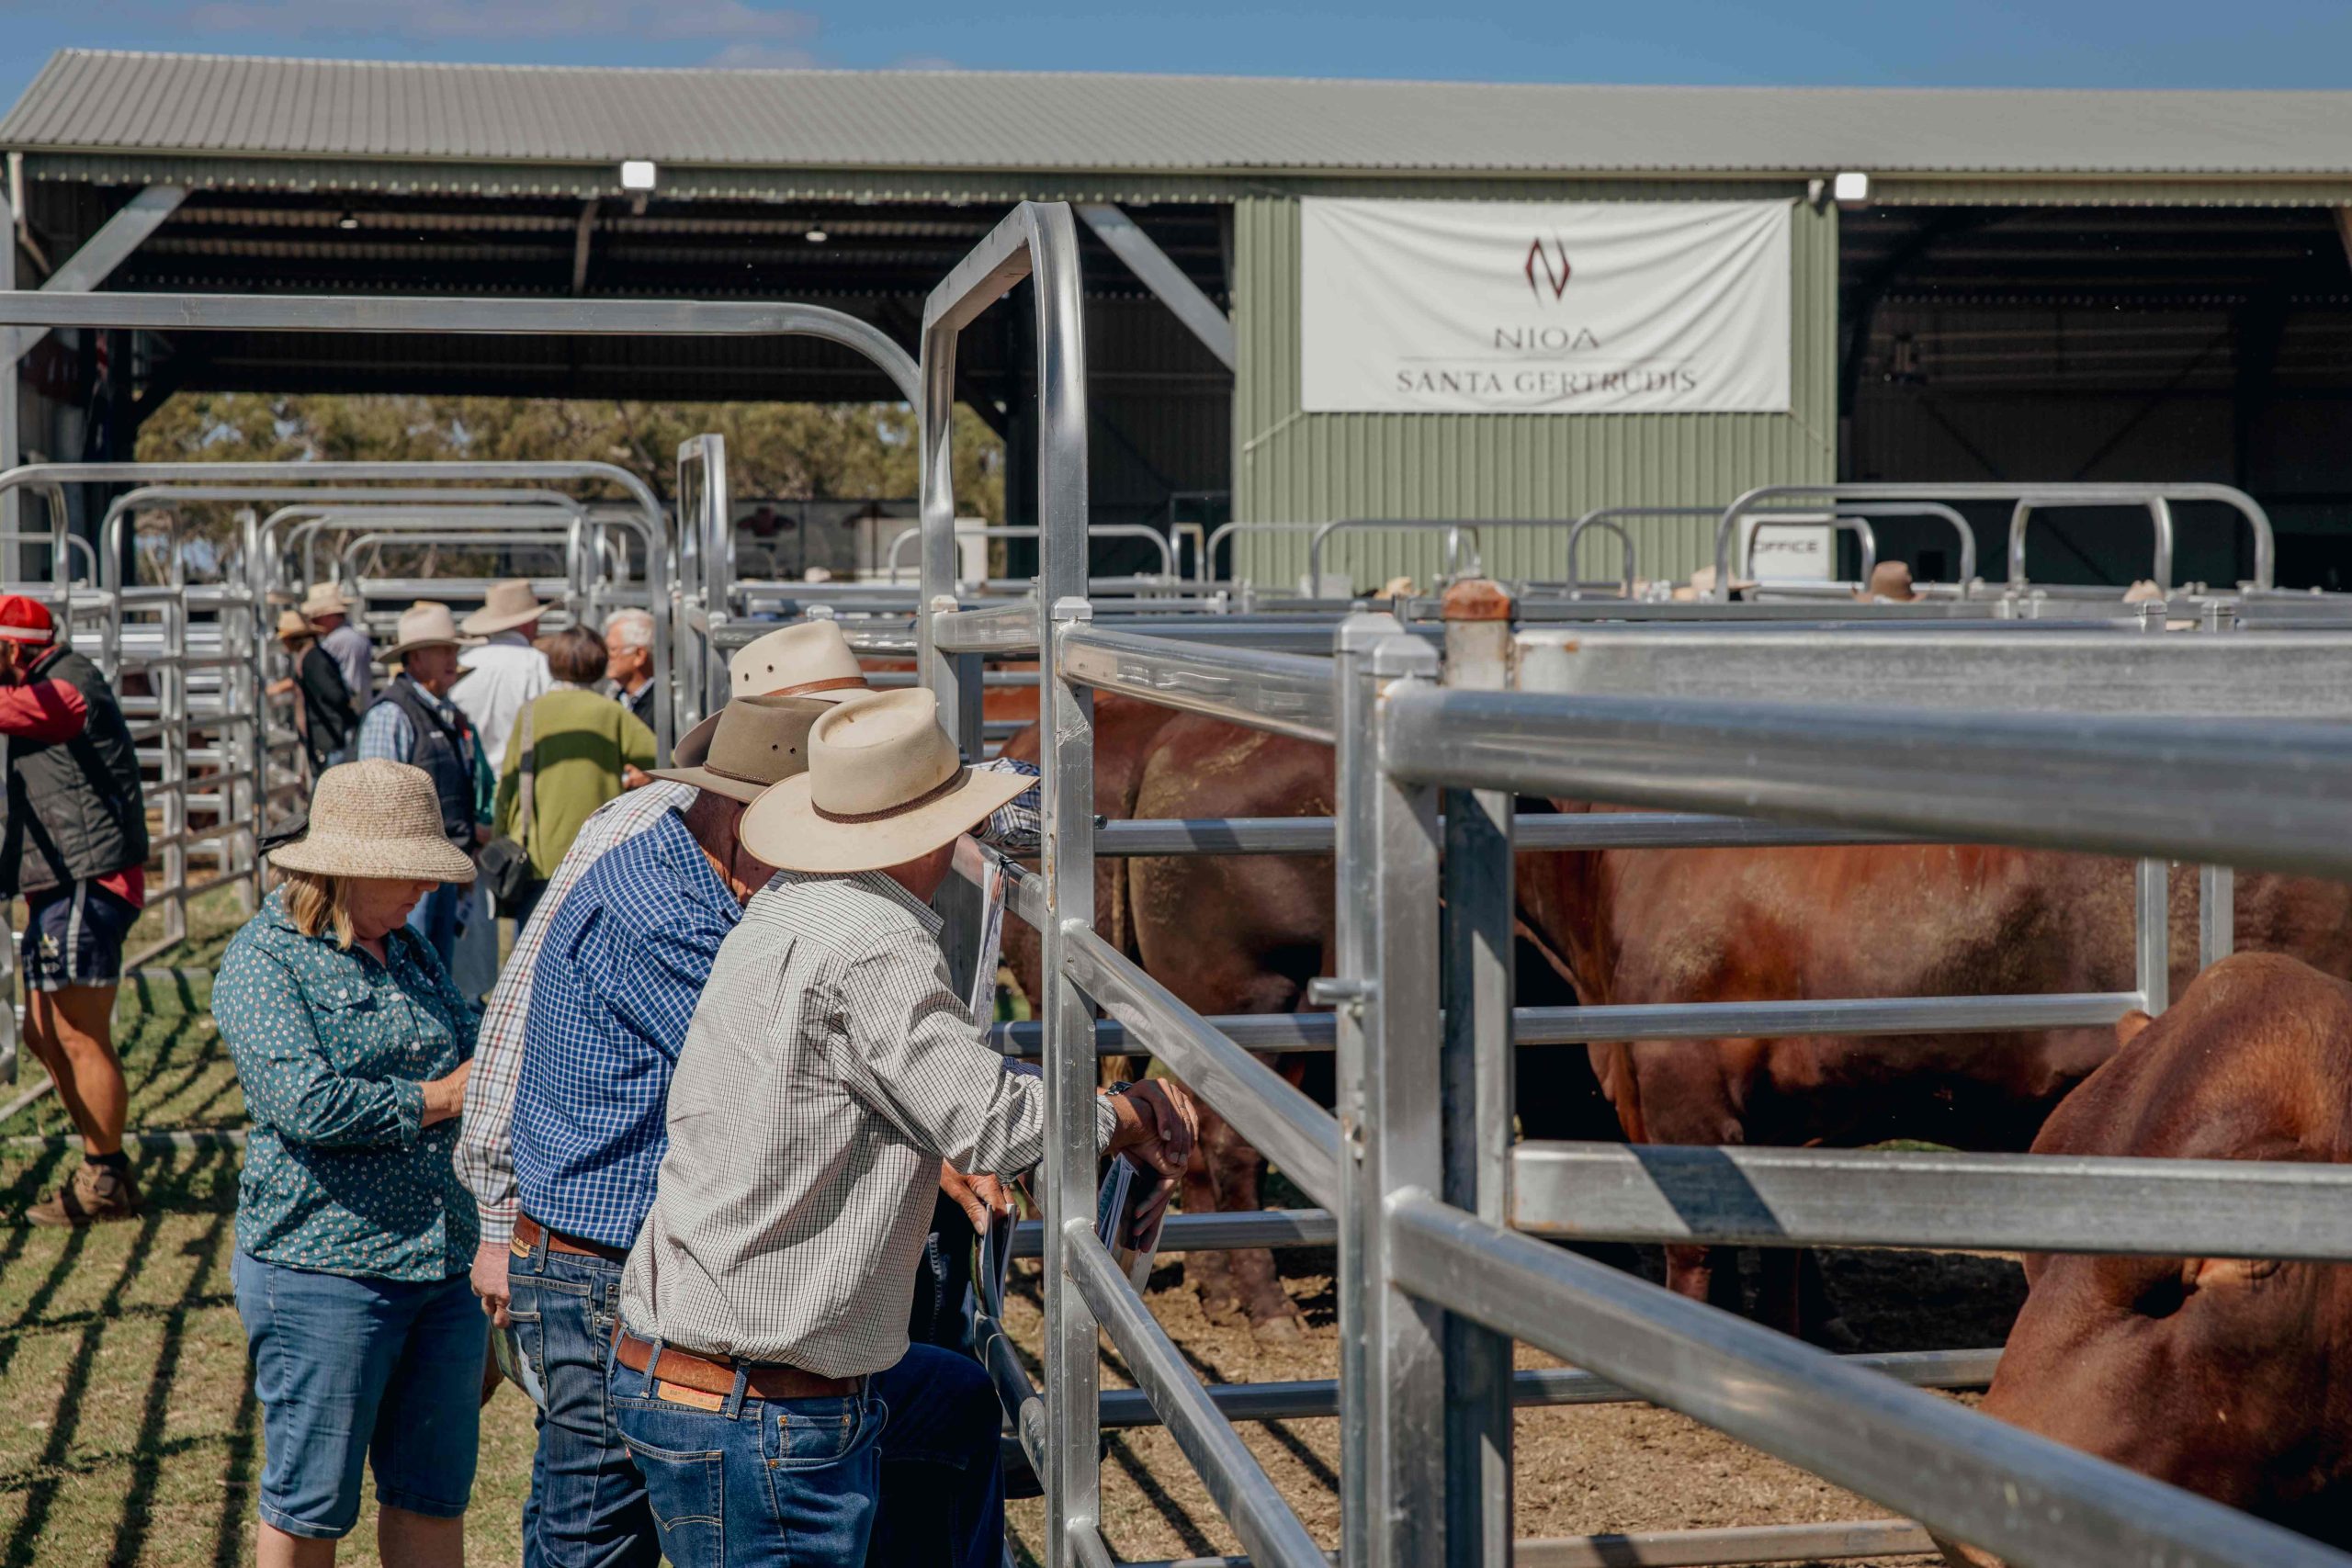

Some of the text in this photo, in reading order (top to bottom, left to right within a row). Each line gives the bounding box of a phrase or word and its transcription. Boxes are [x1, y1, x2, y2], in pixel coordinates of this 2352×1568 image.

[1494, 327, 1600, 349] NIOA
[1396, 369, 1698, 394] SANTA GERTRUDIS
[1754, 540, 1818, 553] OFFICE
